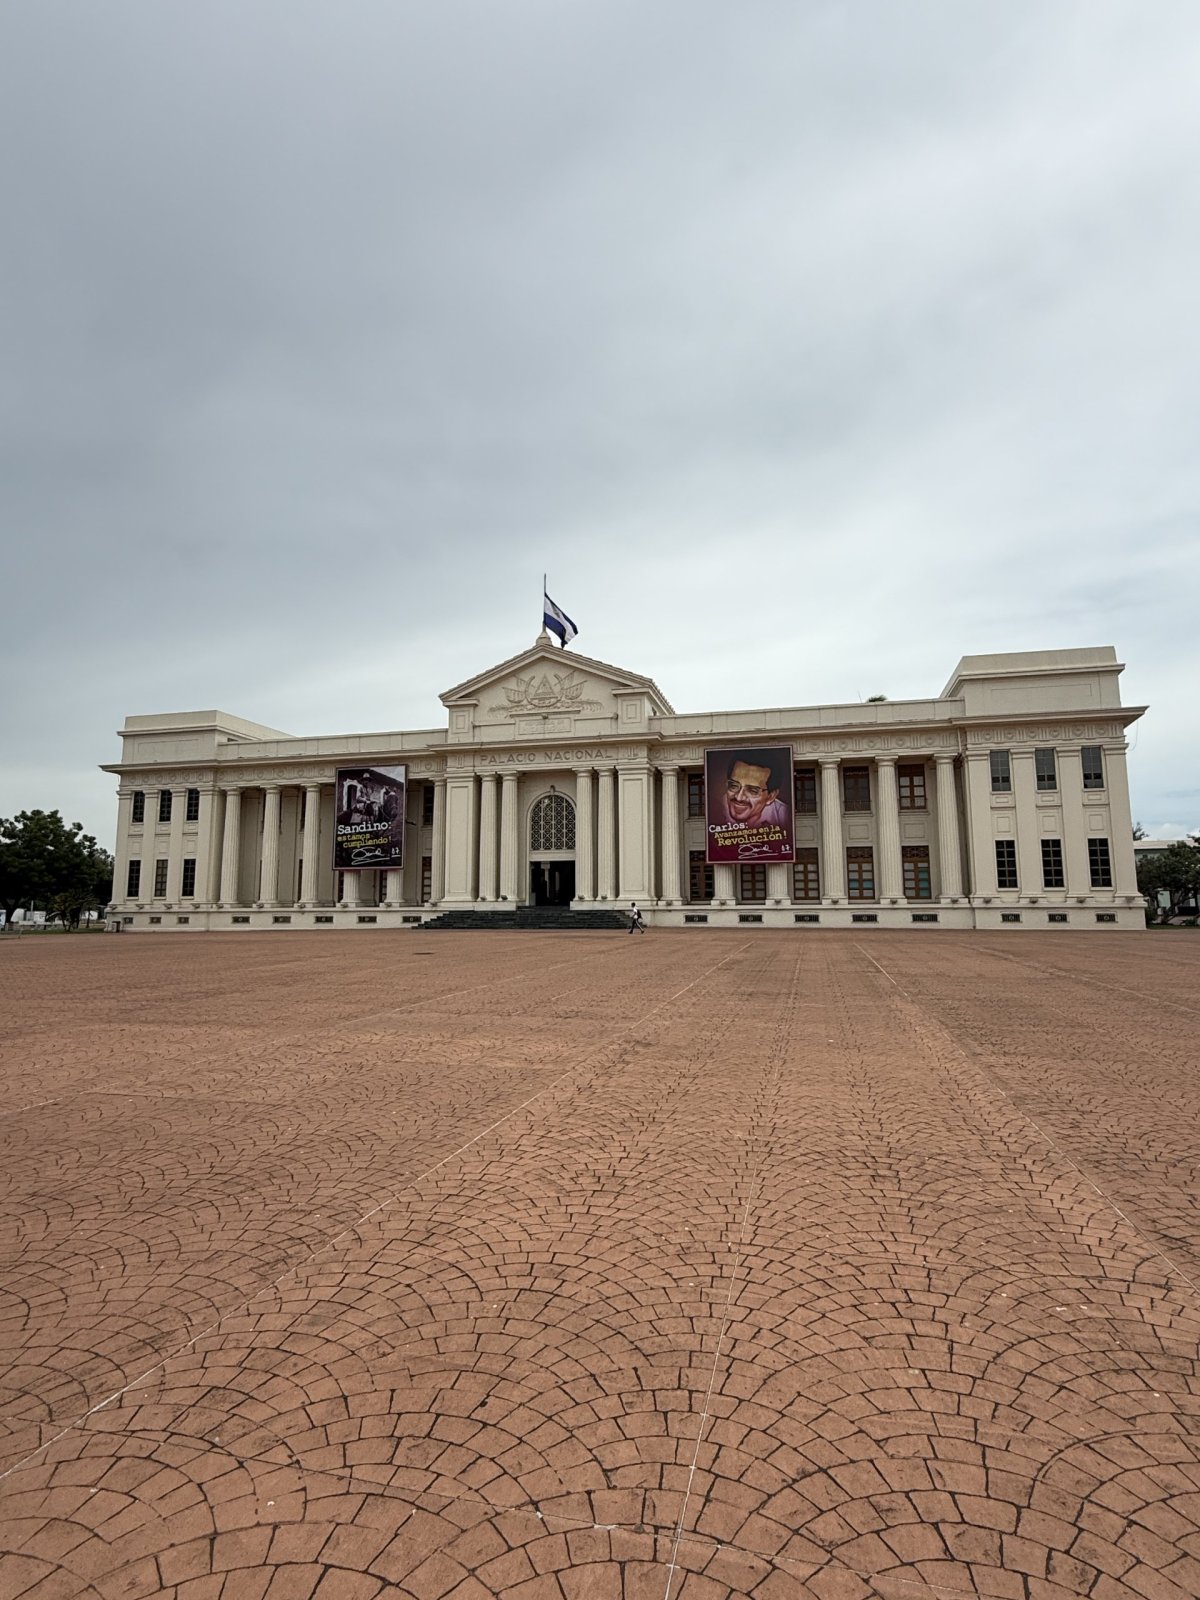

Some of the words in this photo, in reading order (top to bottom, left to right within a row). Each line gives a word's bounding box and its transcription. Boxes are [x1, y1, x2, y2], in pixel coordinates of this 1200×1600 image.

[480, 752, 536, 764] PALACIO
[544, 749, 613, 761] NACIONAL
[337, 821, 391, 834] Sandino:
[709, 822, 748, 832] Carlos:
[337, 833, 371, 842] estamos
[714, 828, 758, 839] Avanzamos
[717, 829, 788, 846] Revolución!
[343, 836, 392, 848] cumpliendo!
